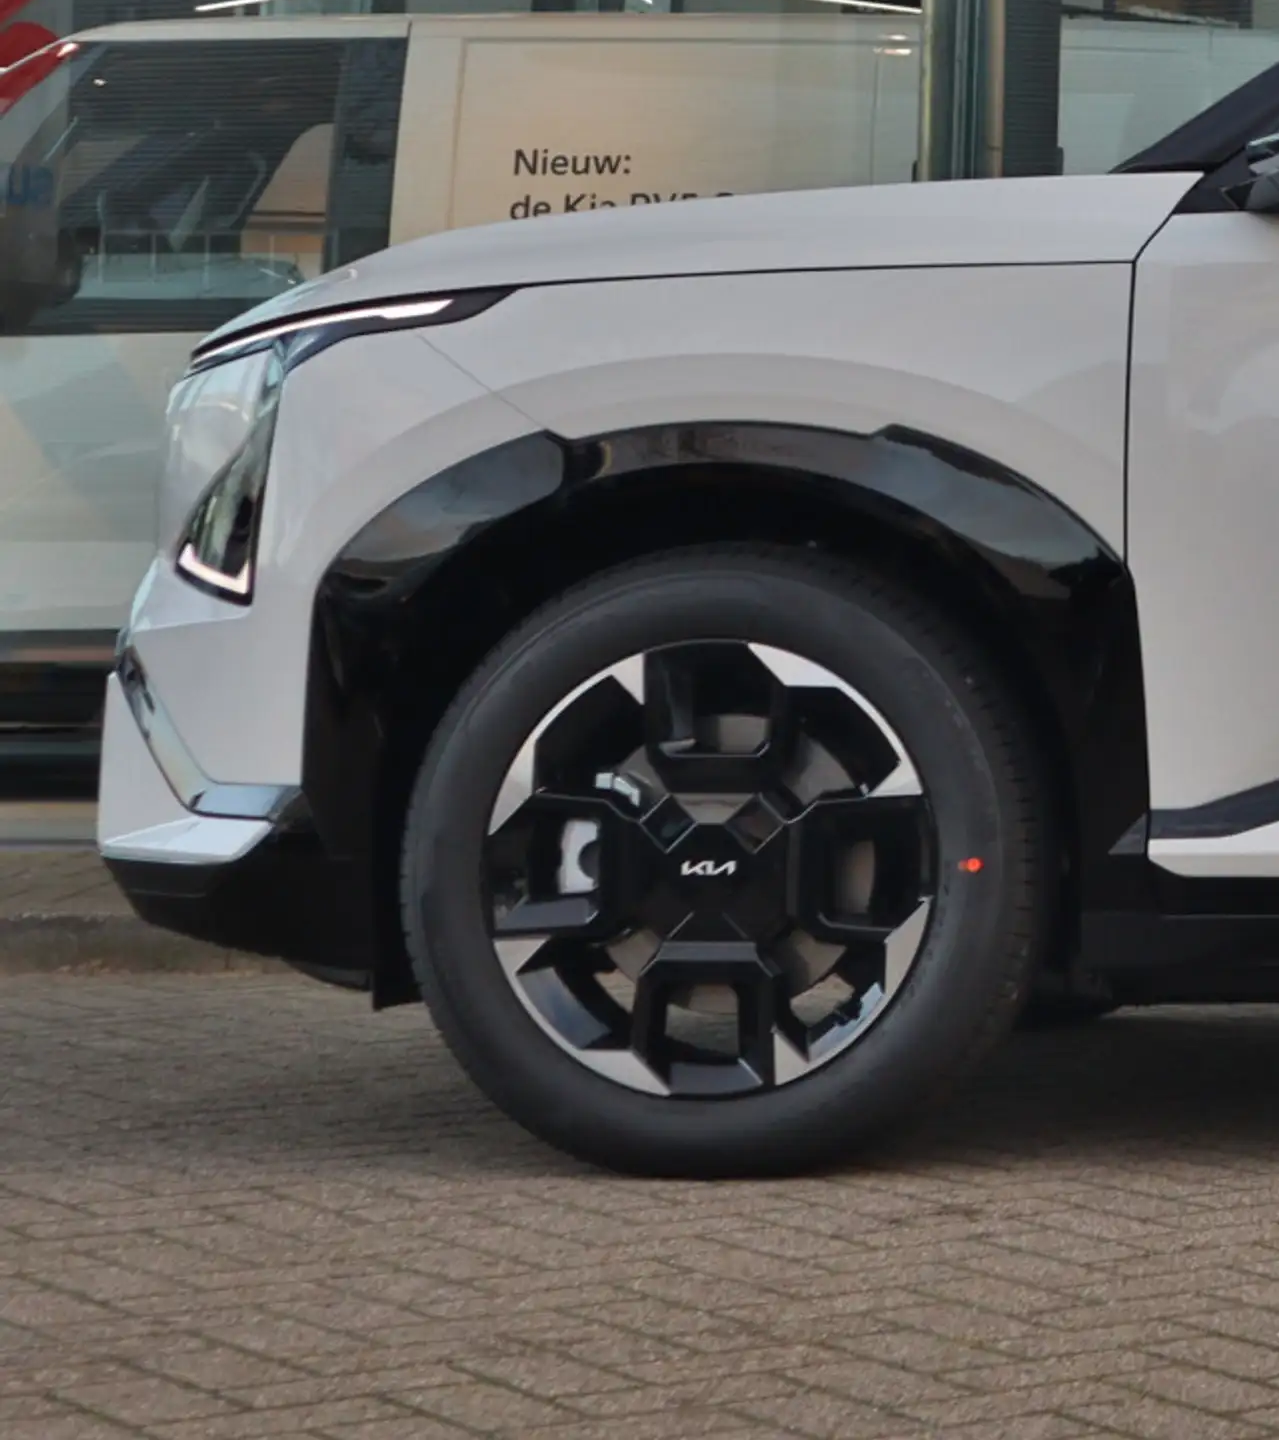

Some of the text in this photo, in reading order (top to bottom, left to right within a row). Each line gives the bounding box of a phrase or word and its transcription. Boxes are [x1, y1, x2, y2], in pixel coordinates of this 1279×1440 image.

[513, 148, 632, 176] Nieuw:
[510, 194, 552, 220] de
[680, 860, 737, 877] KIA
